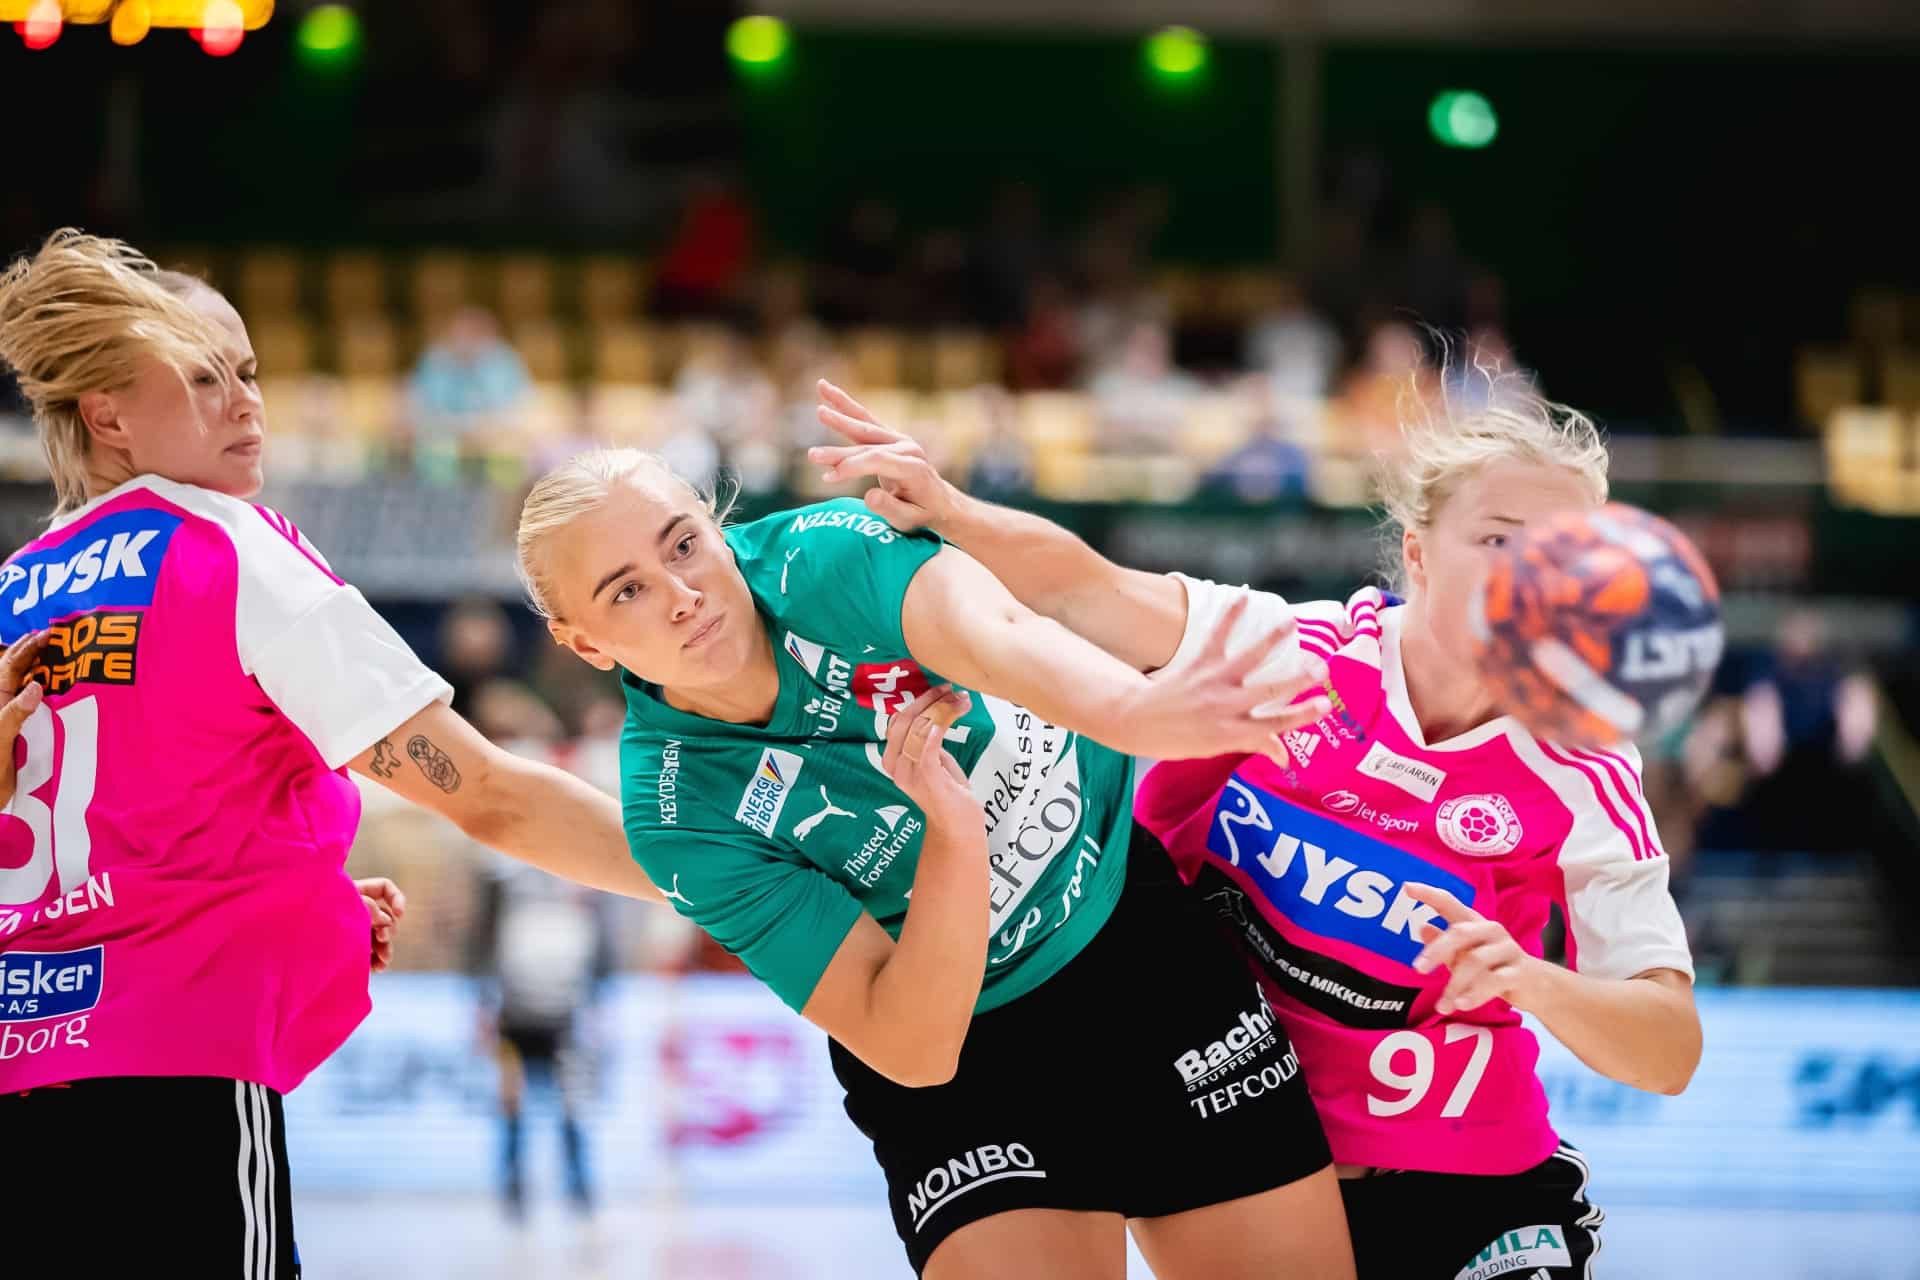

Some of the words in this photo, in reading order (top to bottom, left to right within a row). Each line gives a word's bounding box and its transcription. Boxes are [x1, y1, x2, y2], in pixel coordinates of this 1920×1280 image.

[13, 530, 160, 616] JYSK
[48, 615, 137, 656] ROS
[659, 739, 683, 825] KEYDESIGN
[740, 777, 772, 827] ENERGI
[751, 783, 785, 838] VIBORG
[1354, 802, 1377, 824] Jet
[1377, 813, 1419, 834] Sport
[842, 825, 889, 879] Thisted
[858, 816, 922, 889] Forsikring
[1257, 832, 1449, 945] JYSK
[8, 1000, 38, 1014] A/S
[1310, 975, 1406, 1013] MIKKELSEN
[1186, 1050, 1257, 1093] GRUPPEN
[1258, 1035, 1278, 1055] A/S
[1189, 1050, 1299, 1119] TEFCOLD
[1367, 1023, 1494, 1119] 97
[907, 1142, 1036, 1221] NONBO
[1462, 1254, 1528, 1280] OLDING
